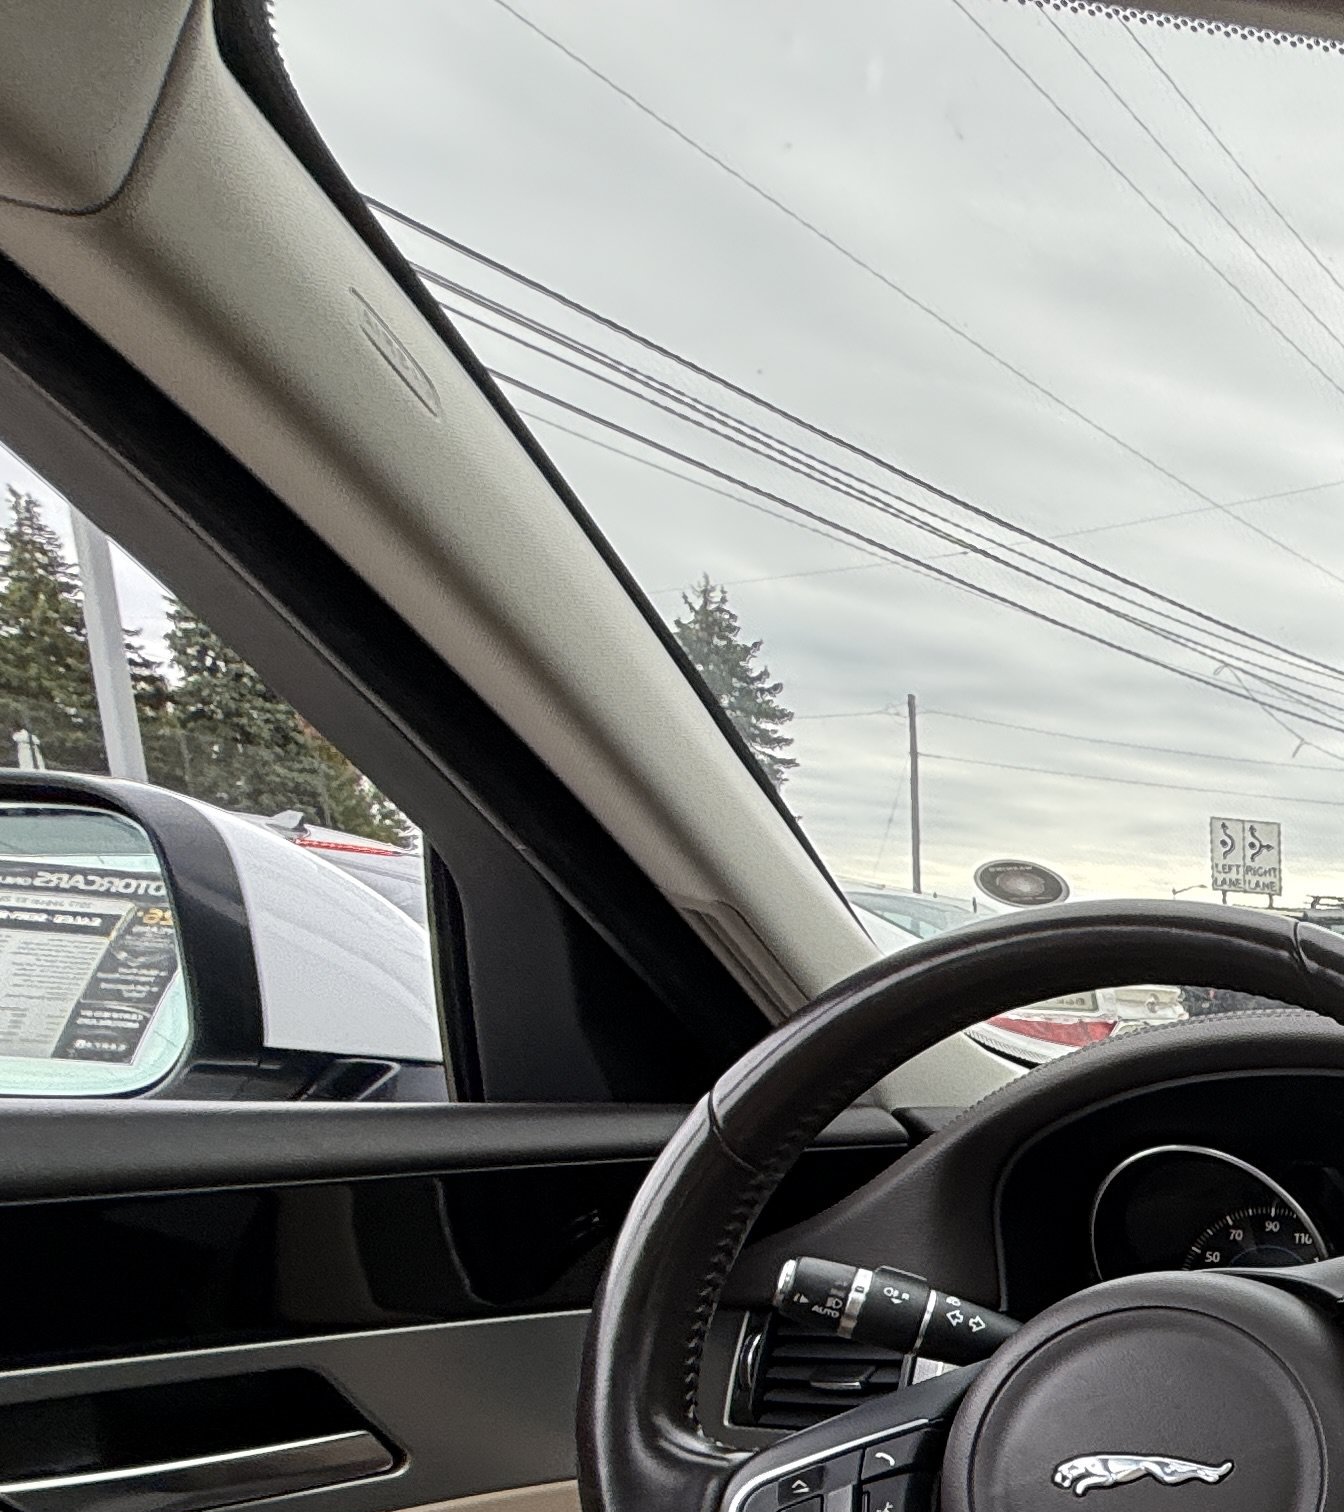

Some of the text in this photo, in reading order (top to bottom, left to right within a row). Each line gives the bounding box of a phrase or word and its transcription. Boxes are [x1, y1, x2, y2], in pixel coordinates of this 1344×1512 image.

[1214, 862, 1242, 876] LEFT
[1245, 865, 1277, 878] RIGHT
[1213, 876, 1243, 889] LANE
[1247, 879, 1277, 892] LANE
[1264, 1220, 1281, 1233] 90
[1228, 1228, 1244, 1241] 70
[1204, 1251, 1221, 1264] 50
[811, 1305, 840, 1319] AUTO
